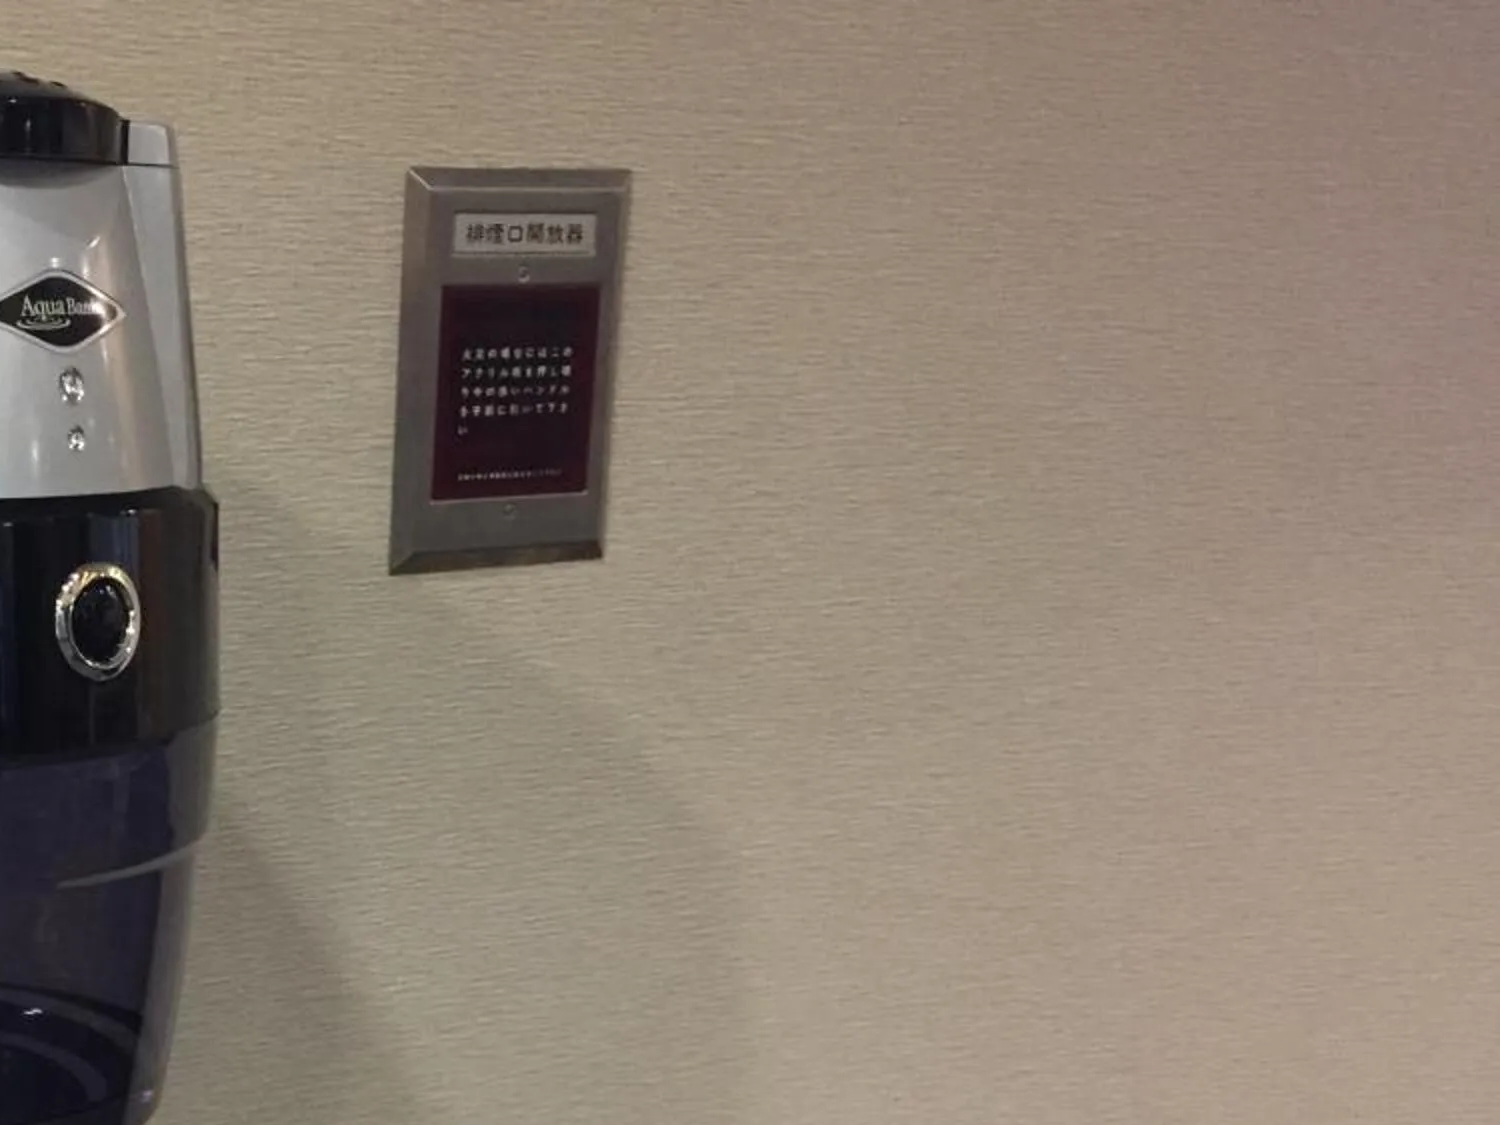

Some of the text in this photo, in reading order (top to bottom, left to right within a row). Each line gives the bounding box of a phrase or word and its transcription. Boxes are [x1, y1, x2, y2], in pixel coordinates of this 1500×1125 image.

[465, 222, 585, 246] 排煙口開放器
[21, 294, 103, 321] Aqua Ban
